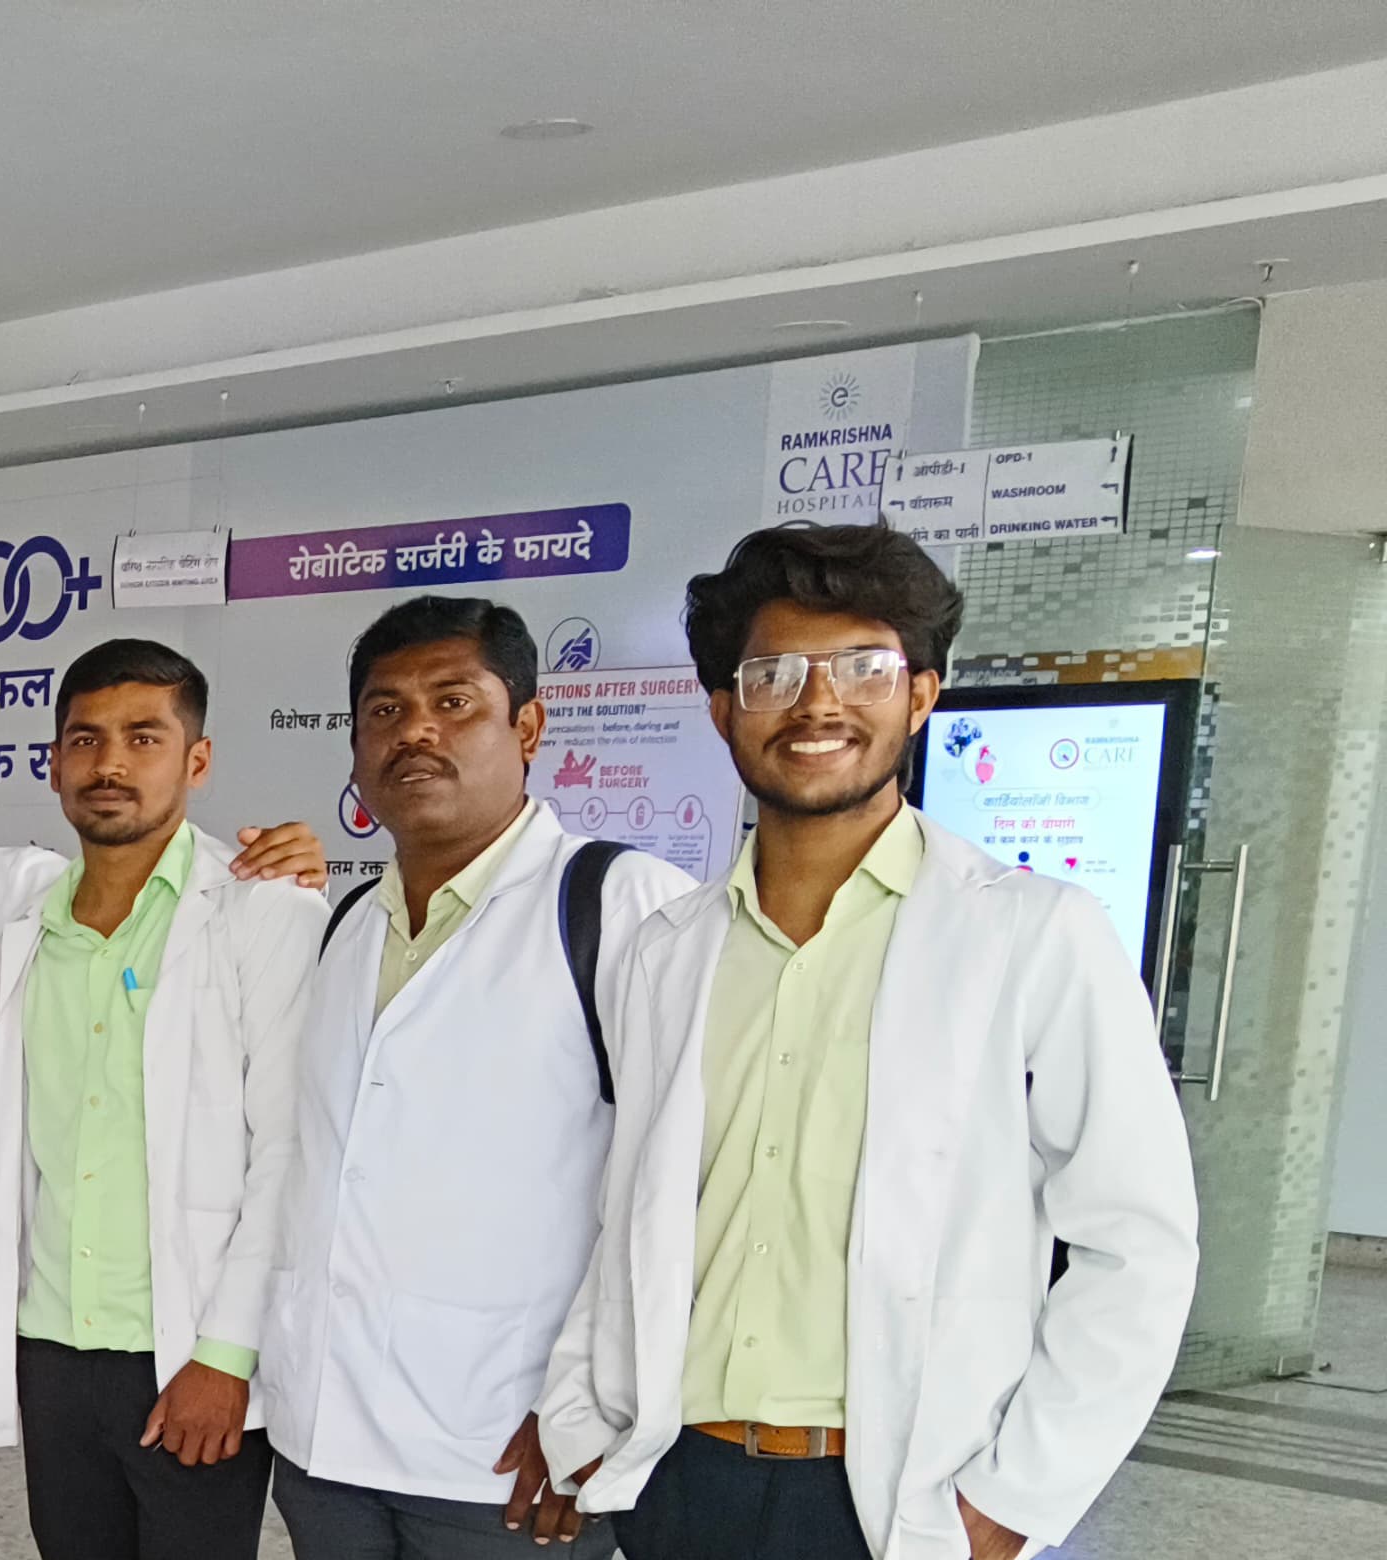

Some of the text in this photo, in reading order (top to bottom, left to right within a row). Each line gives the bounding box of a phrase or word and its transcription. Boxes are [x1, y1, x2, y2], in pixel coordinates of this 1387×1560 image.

[781, 423, 893, 452] RAMKRISHNA
[995, 452, 1033, 465] OPD-1
[779, 448, 892, 494] CARE
[991, 484, 1066, 499] WASHROOM
[934, 529, 950, 540] का
[955, 523, 979, 539] पानी
[990, 517, 1098, 535] DRINKING WATER
[289, 521, 594, 581] रोबोटिक सर्जरी के फायदे
[538, 679, 701, 700] ECTIONS AFTER SURGERY
[576, 705, 593, 717] THE
[596, 704, 647, 717] SOLUTION?
[270, 708, 353, 731] विशेषज्ञ द्वार
[599, 765, 643, 777] BEFORE
[598, 777, 650, 789] SURGERY
[359, 860, 389, 876] रक्त
